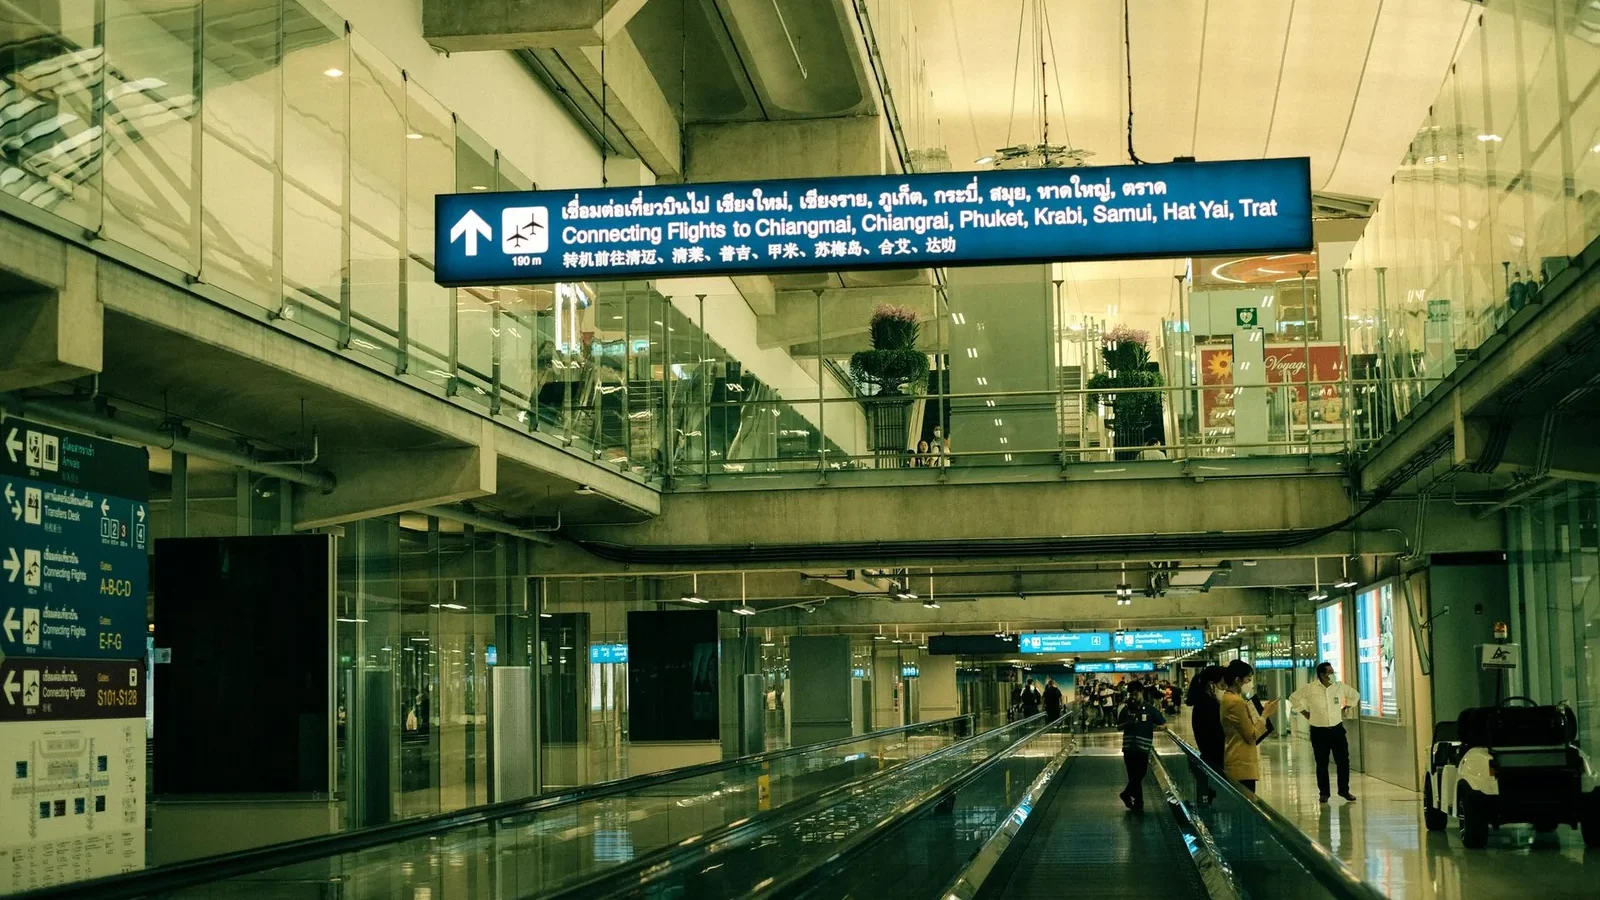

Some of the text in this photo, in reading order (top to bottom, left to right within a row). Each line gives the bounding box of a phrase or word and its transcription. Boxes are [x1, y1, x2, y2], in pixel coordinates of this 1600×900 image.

[562, 175, 1167, 219] เชื่อมต่อเที่ยวบินไป เชียงใหม่, เชียงราย, ภูเก็ต, กระบี่, สมุย, หาดใหญ่, ตราด
[562, 198, 1278, 245] Connecting Flights to Chiangmai, Chiangrai, Phuket, Krabi, Samui, Hat Yai, Trat
[511, 255, 542, 266] 190 m
[62, 455, 80, 469] Arrivals
[67, 509, 81, 522] Desk
[121, 525, 126, 537] 3
[43, 565, 87, 583] Connecting Flights
[99, 578, 132, 597] A-B-C-D
[42, 623, 87, 639] Connecting Flights
[99, 632, 122, 650] E-F-G
[42, 686, 86, 700] Connecting Flights
[97, 689, 138, 706] S101-S128
